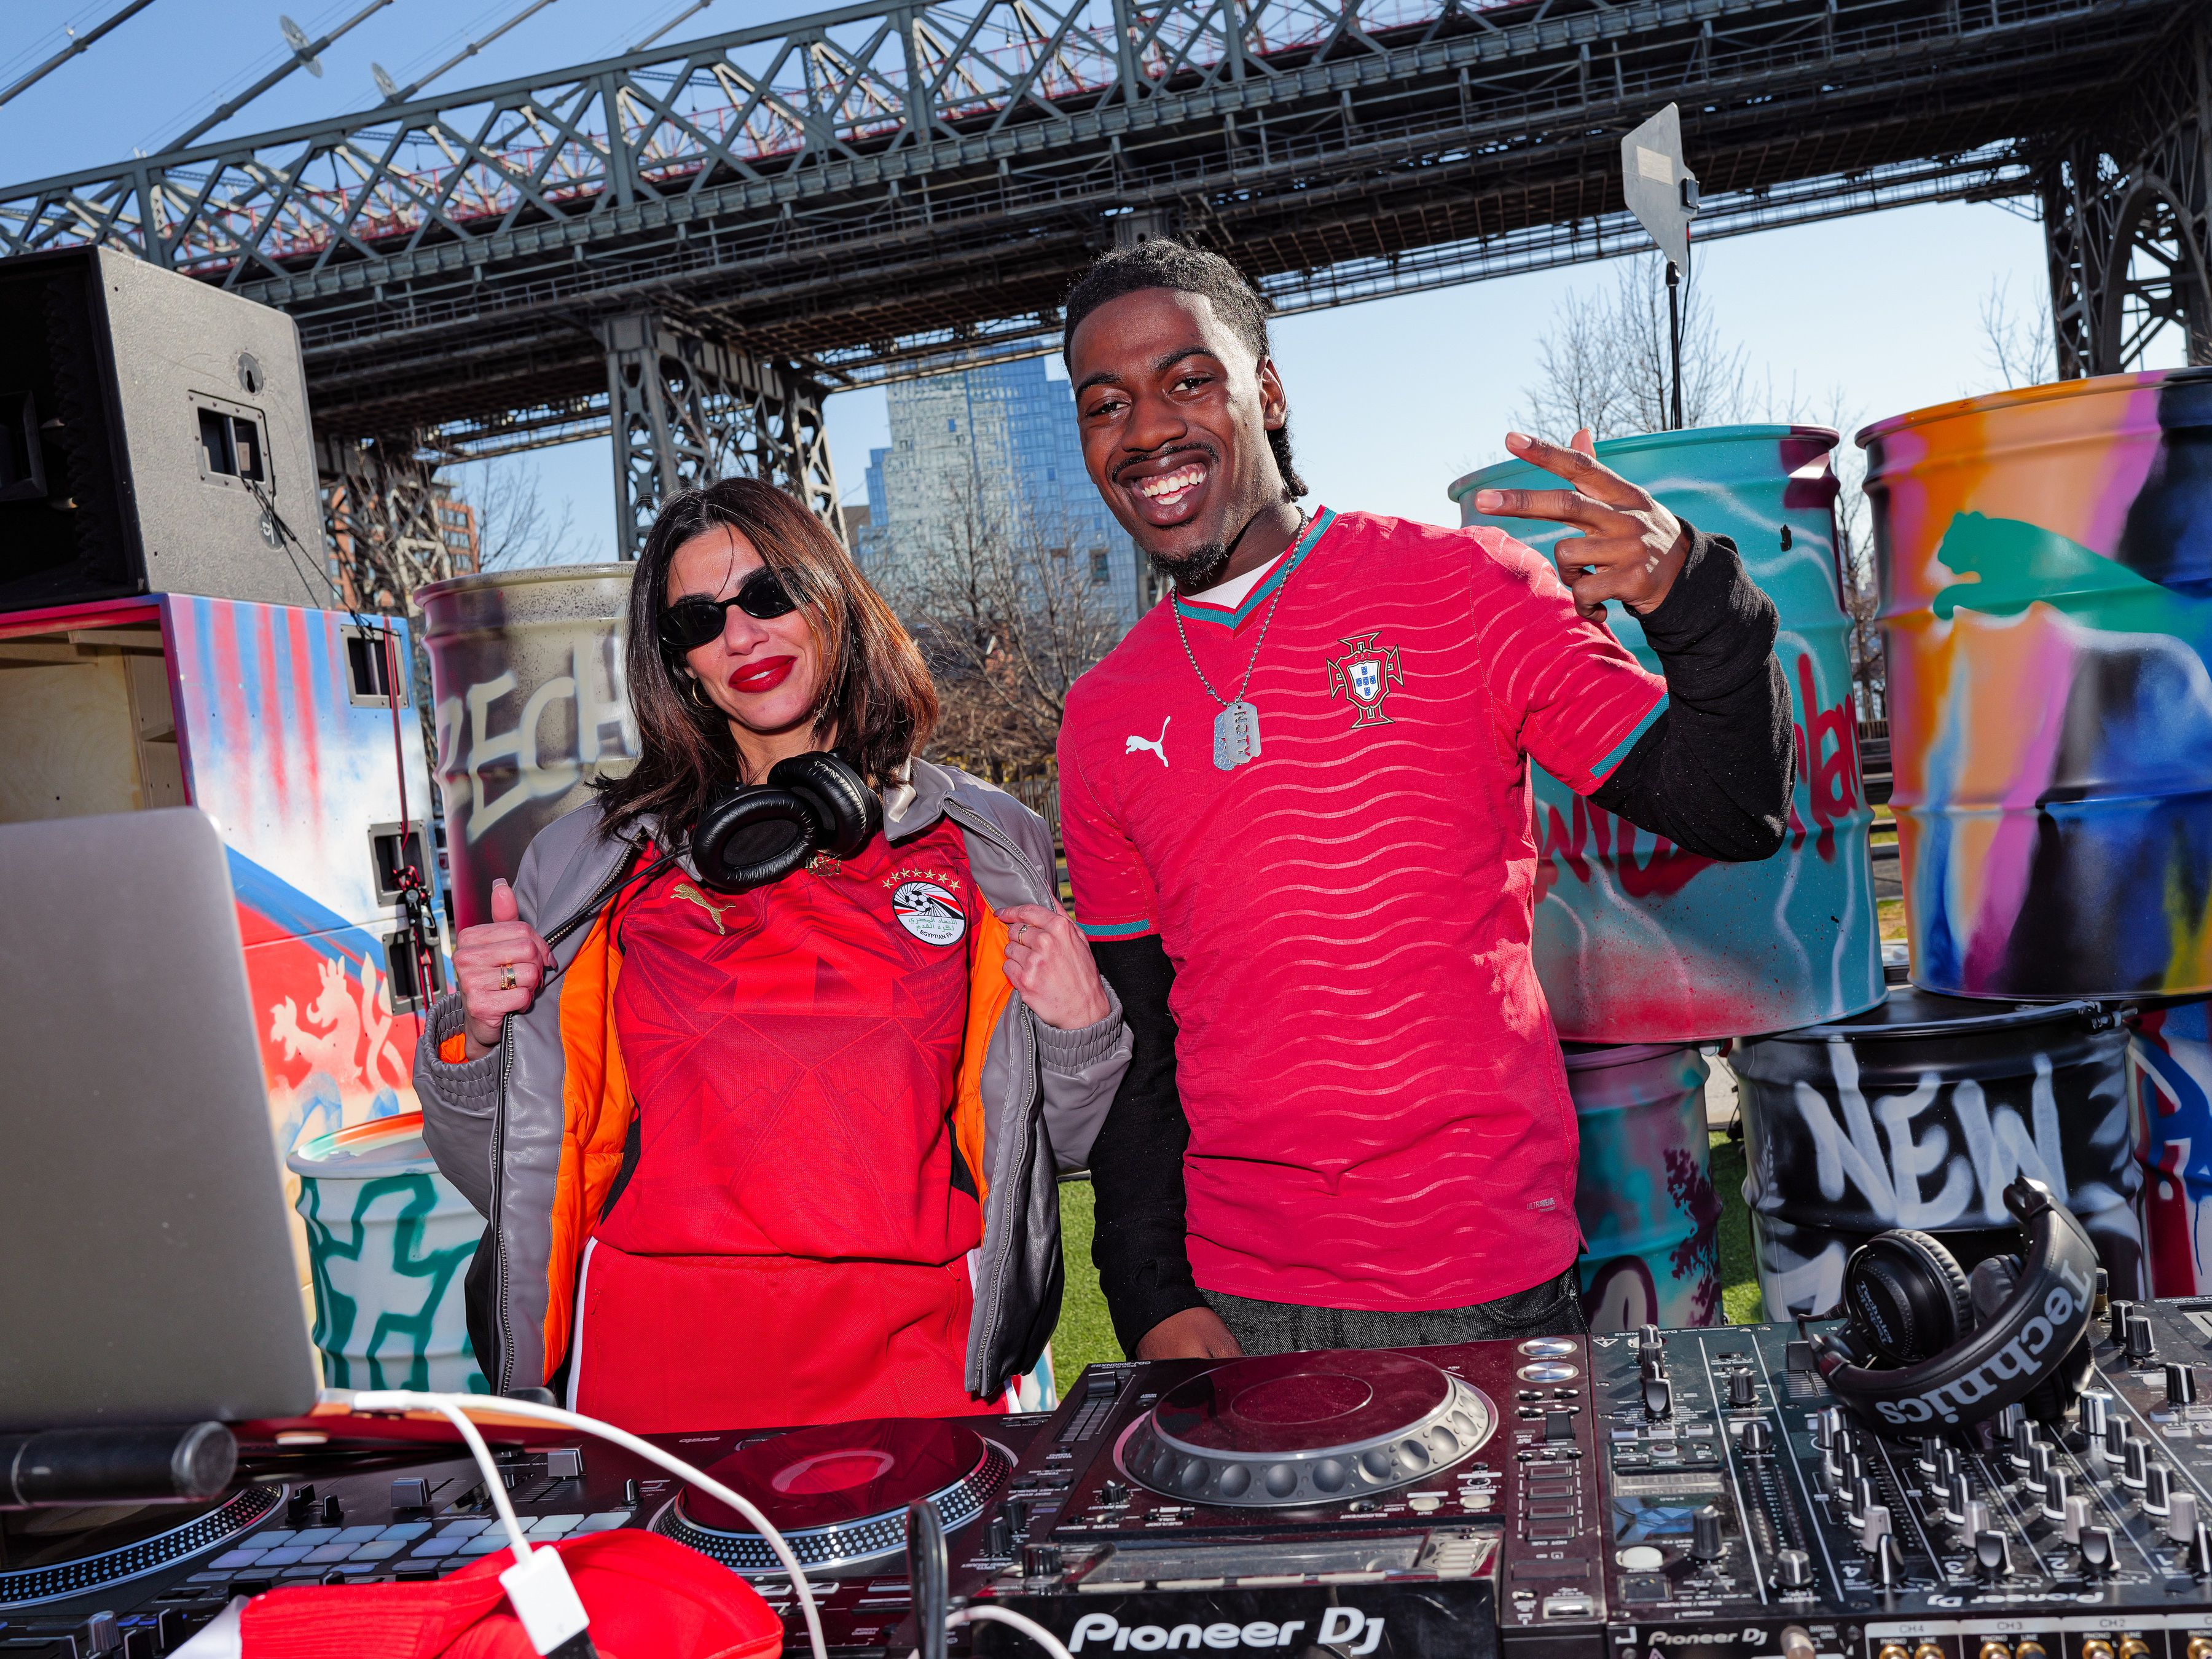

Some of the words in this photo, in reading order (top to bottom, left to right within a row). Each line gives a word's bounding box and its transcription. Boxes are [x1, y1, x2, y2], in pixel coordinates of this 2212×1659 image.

[920, 930, 946, 939] EGYPTIAN
[1795, 1036, 2068, 1230] NEW
[1856, 1284, 1888, 1346] Technics
[1860, 1281, 1893, 1343] Technics
[1875, 1260, 2092, 1424] Technics
[2047, 1558, 2069, 1569] 2
[2155, 1554, 2173, 1566] 1
[1842, 1566, 1861, 1578] 4
[1945, 1561, 1964, 1574] 3
[1971, 1592, 2103, 1604] Pioneer
[1067, 1612, 1306, 1653] Pioneer
[1648, 1631, 1739, 1647] Pioneer
